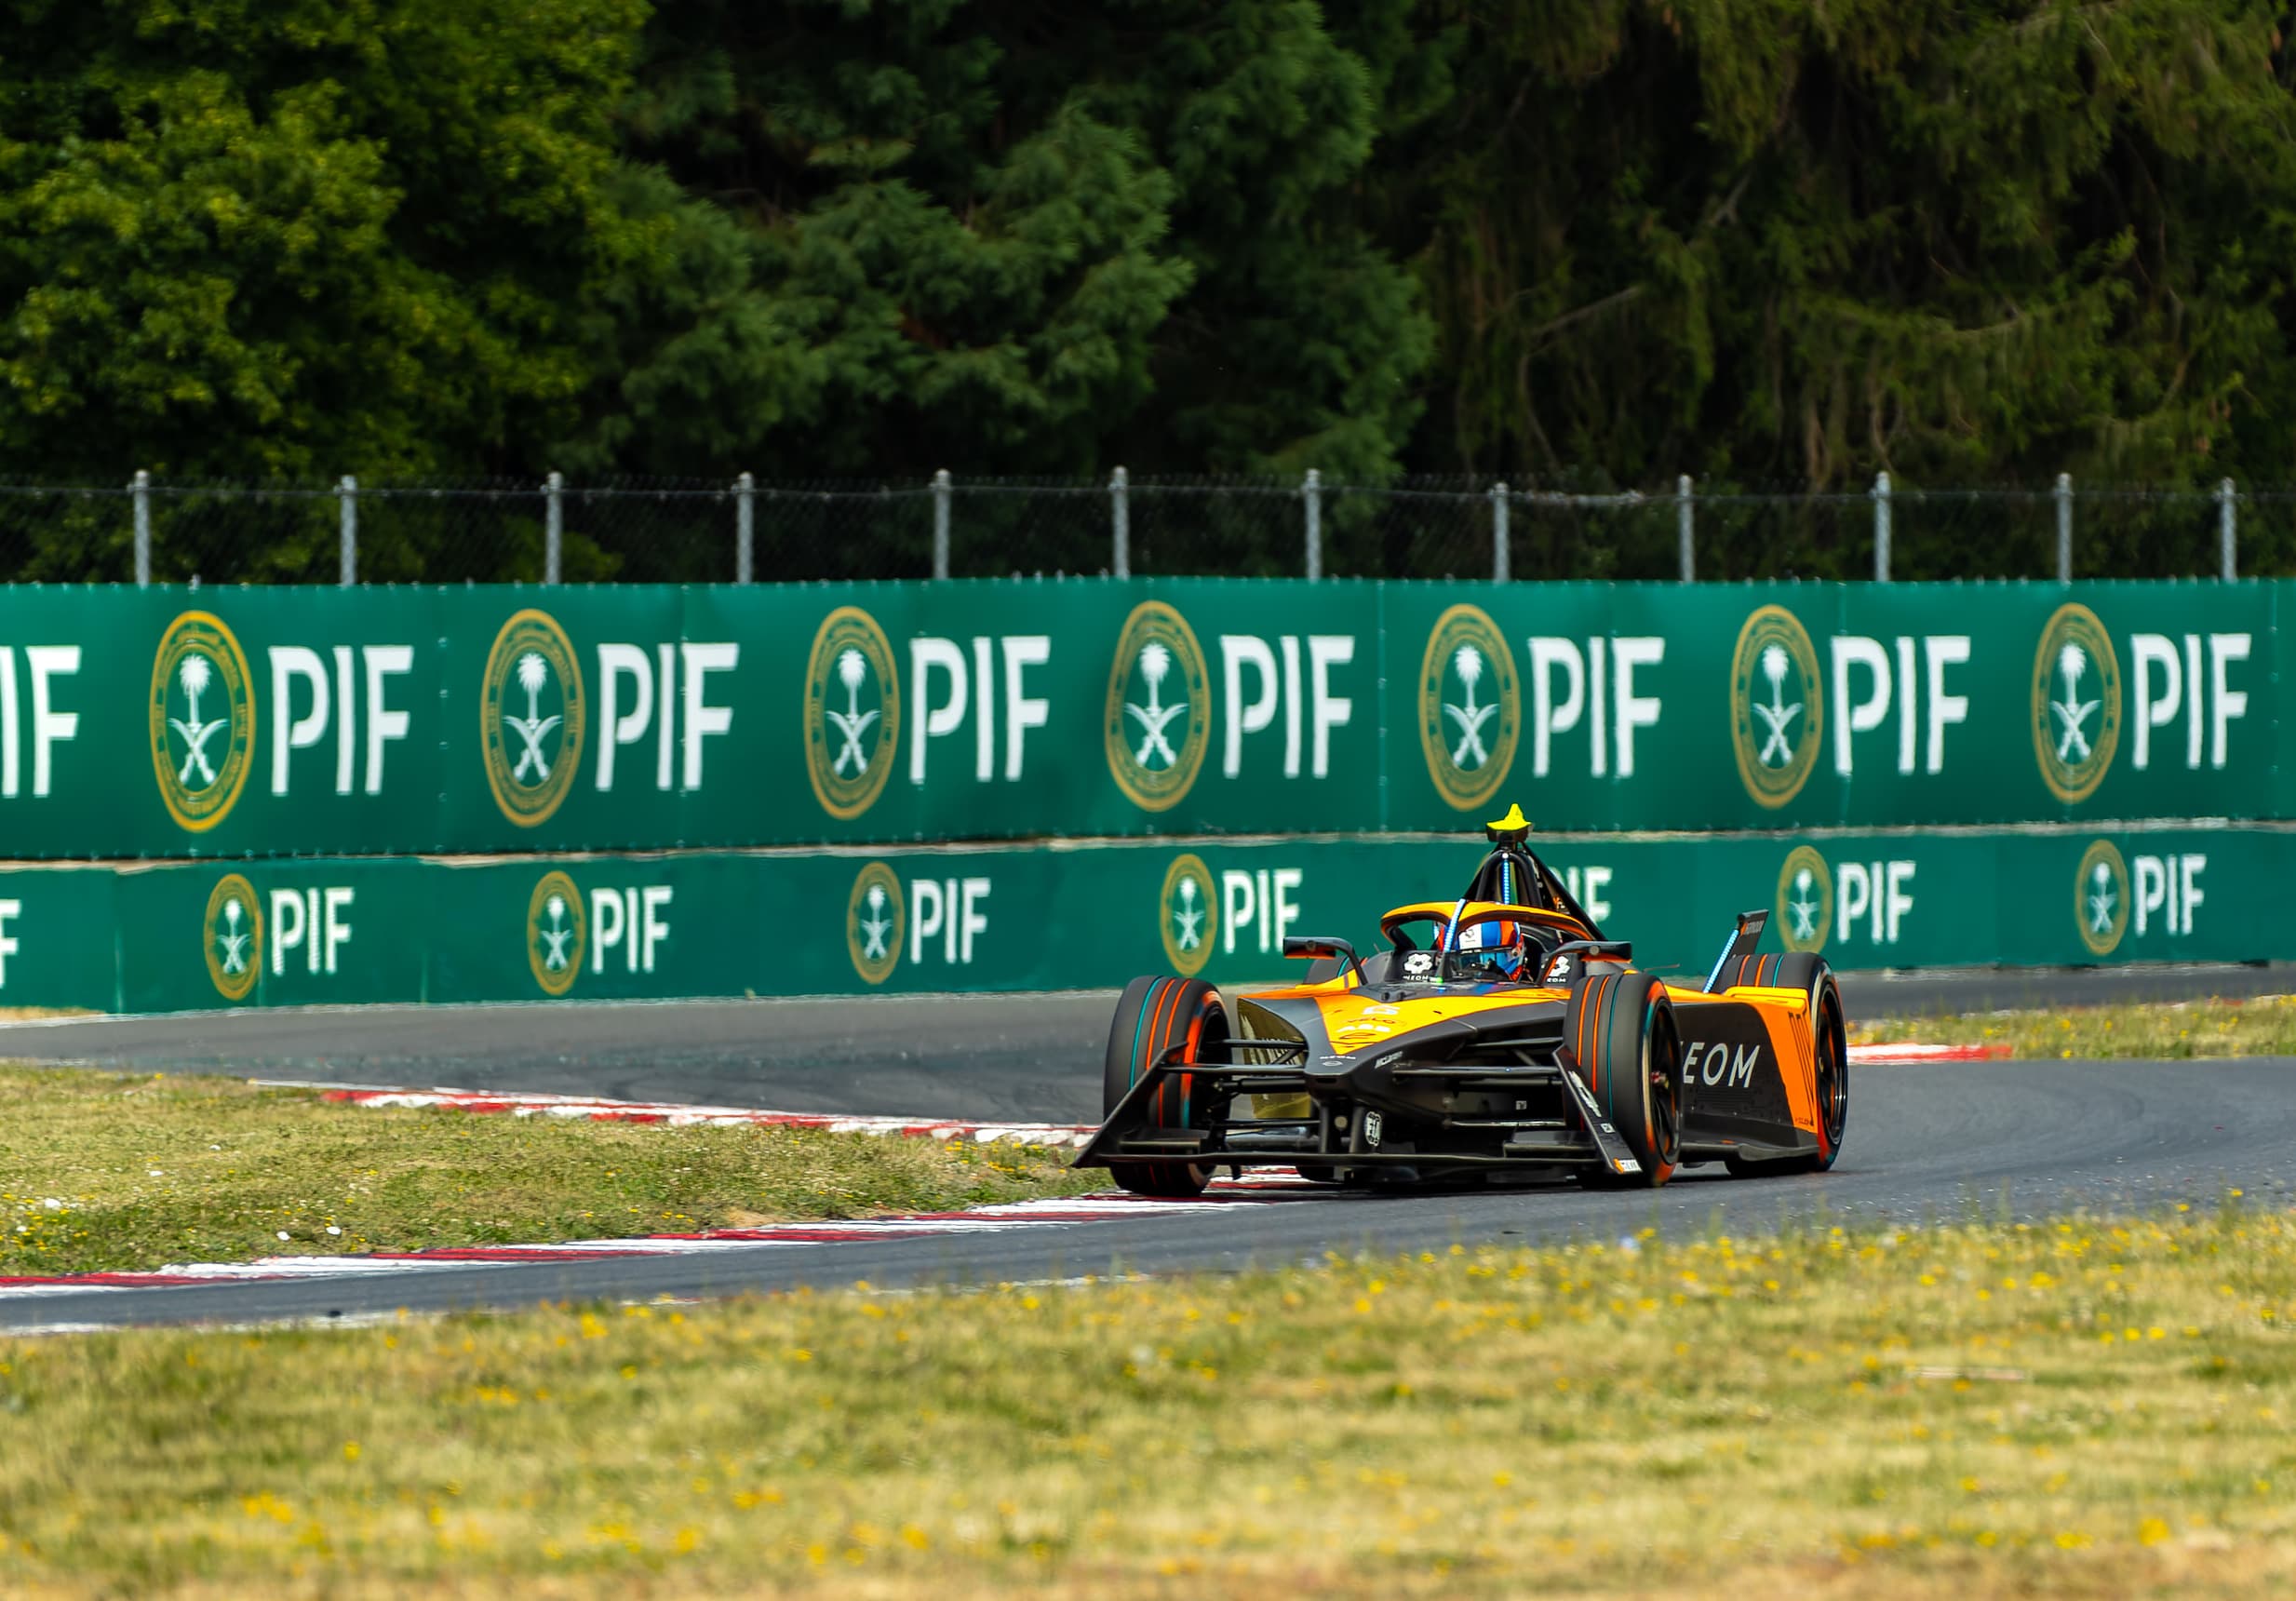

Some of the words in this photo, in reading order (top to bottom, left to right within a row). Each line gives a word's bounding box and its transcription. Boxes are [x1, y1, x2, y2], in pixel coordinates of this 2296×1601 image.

[0, 645, 81, 797] IF
[268, 646, 413, 795] PIF
[596, 642, 739, 790] PIF
[910, 635, 1052, 785] PIF
[1220, 635, 1355, 777] PIF
[1529, 637, 1666, 776] PIF
[1832, 636, 1972, 776] PIF
[2131, 633, 2251, 768] PIF
[271, 887, 355, 975] PIF
[591, 885, 673, 973] PIF
[910, 878, 991, 963] PIF
[1223, 868, 1303, 953] PIF
[1549, 866, 1613, 923] IF
[1838, 860, 1916, 943] PIF
[2134, 854, 2207, 934] PIF
[1680, 1041, 1761, 1088] EOM
